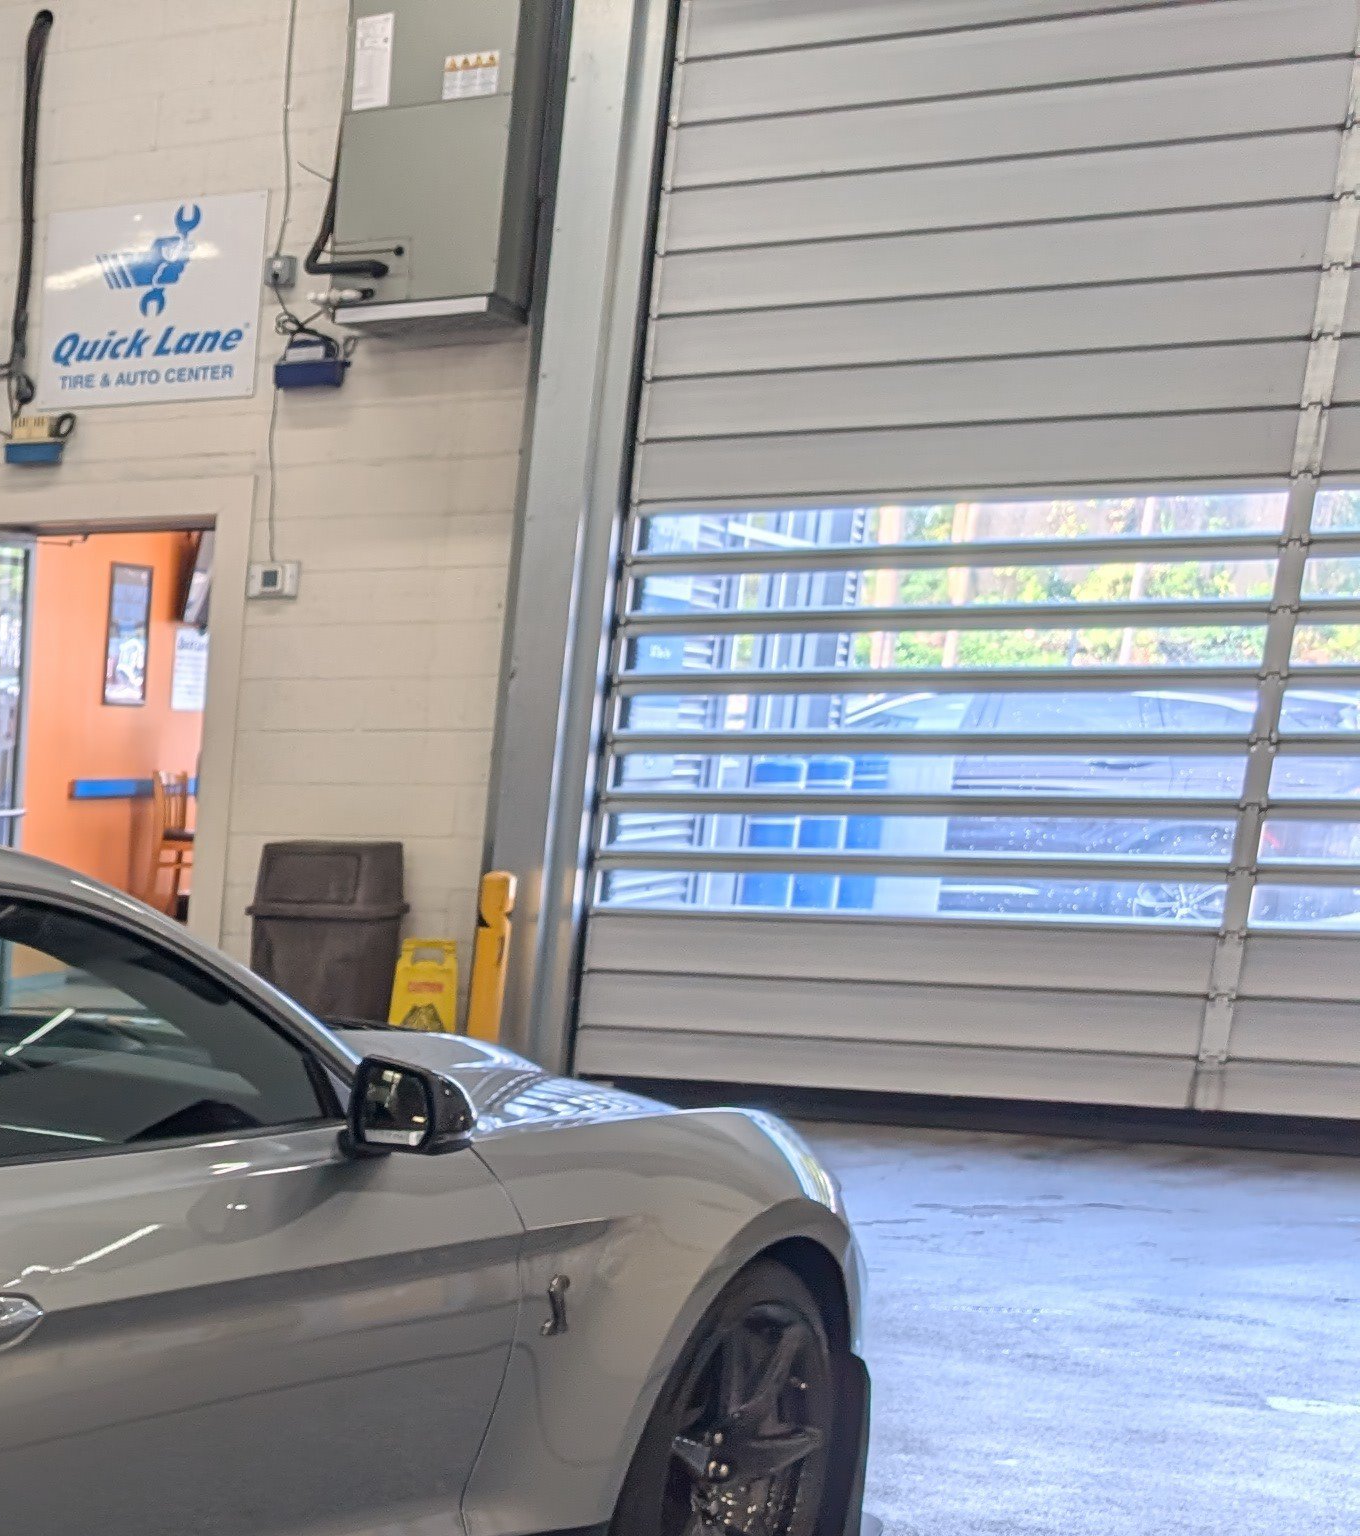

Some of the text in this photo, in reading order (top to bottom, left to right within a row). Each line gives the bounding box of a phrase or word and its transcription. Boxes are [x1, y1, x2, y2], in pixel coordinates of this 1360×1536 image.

[52, 325, 243, 367] Quick Lane
[60, 364, 234, 390] TIRE & AUTO CENTER
